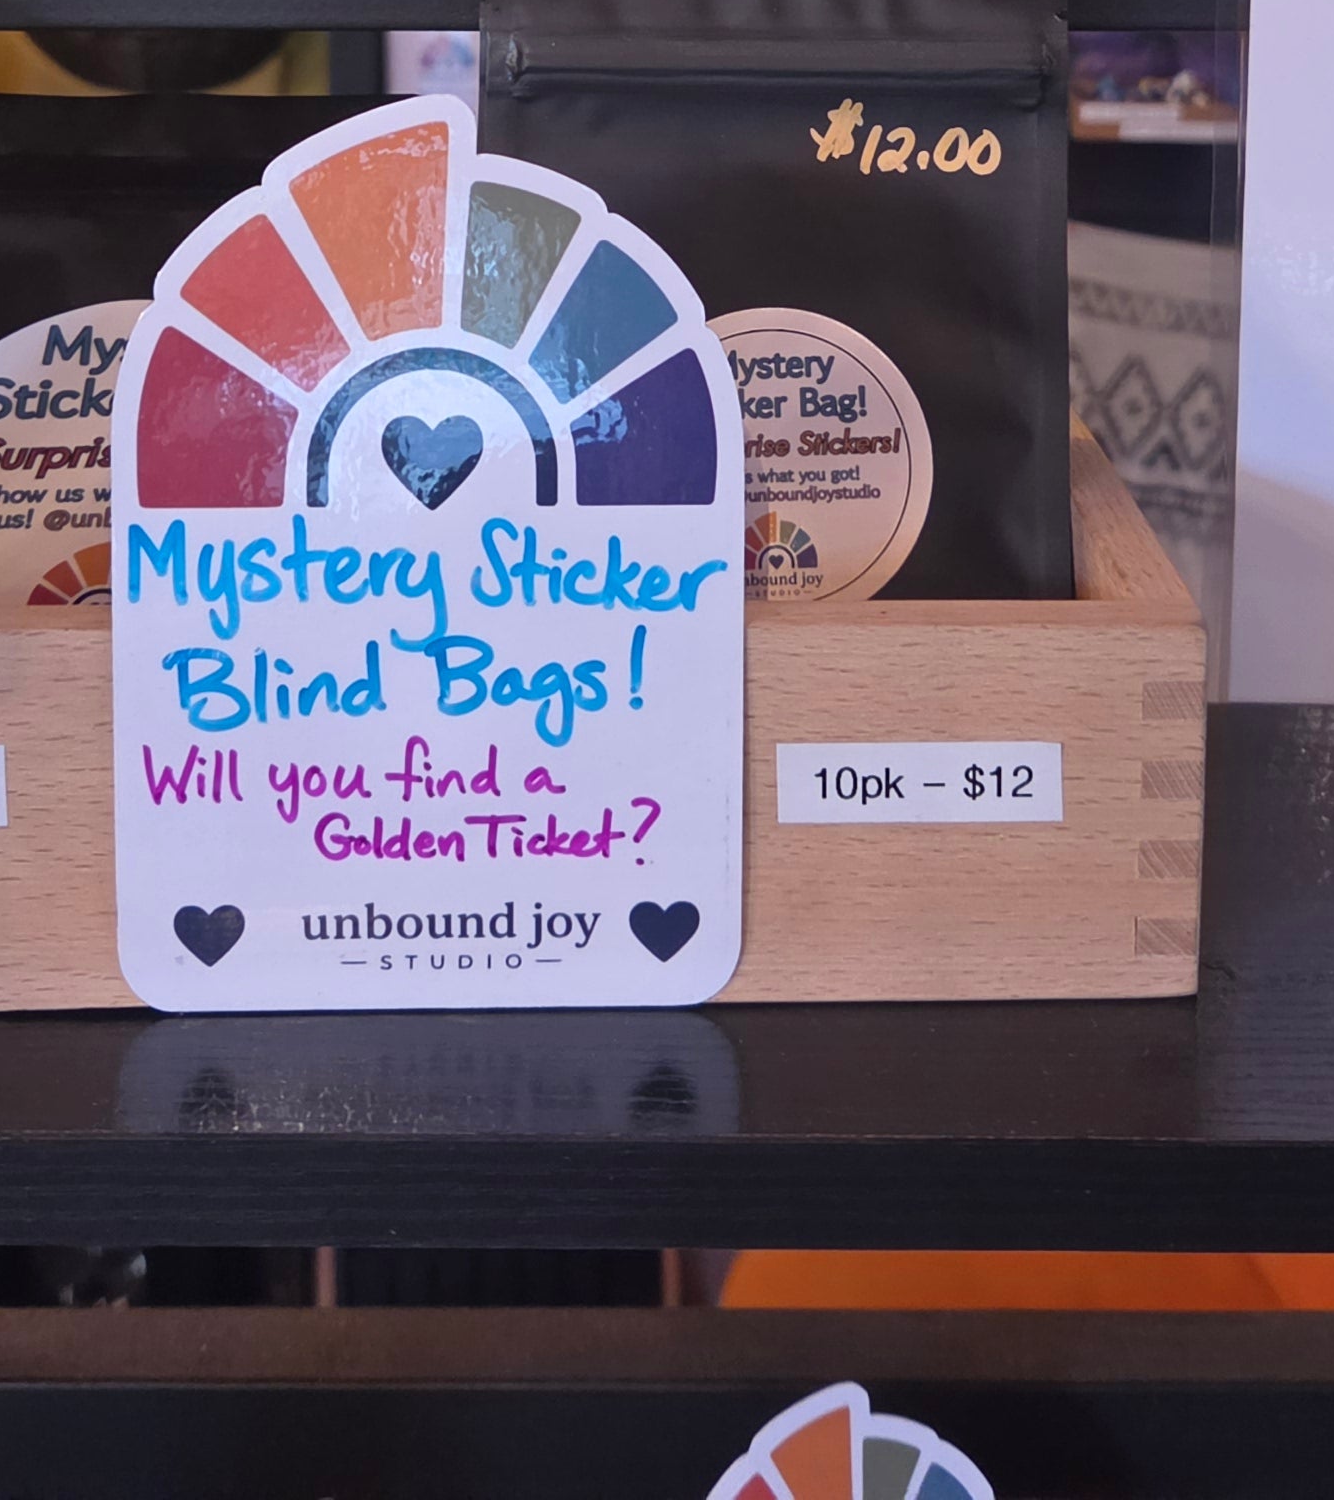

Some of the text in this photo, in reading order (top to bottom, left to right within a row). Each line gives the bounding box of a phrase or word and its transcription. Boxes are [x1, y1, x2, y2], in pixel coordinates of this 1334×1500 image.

[810, 98, 1002, 175] $12.00
[800, 385, 867, 423] Bag!
[745, 484, 881, 503] unboundjoystudio
[757, 468, 794, 483] what
[799, 470, 826, 485] you
[831, 465, 860, 484] got!
[55, 488, 85, 503] us
[125, 516, 728, 648] Mystery Sticker
[801, 572, 824, 588] joy
[161, 626, 649, 748] Blind Bags!
[142, 736, 566, 825] Will you find a
[814, 766, 905, 805] 10pk
[963, 764, 1033, 800] $12
[302, 903, 602, 951] unbound joy
[379, 954, 524, 971] STUDIO
